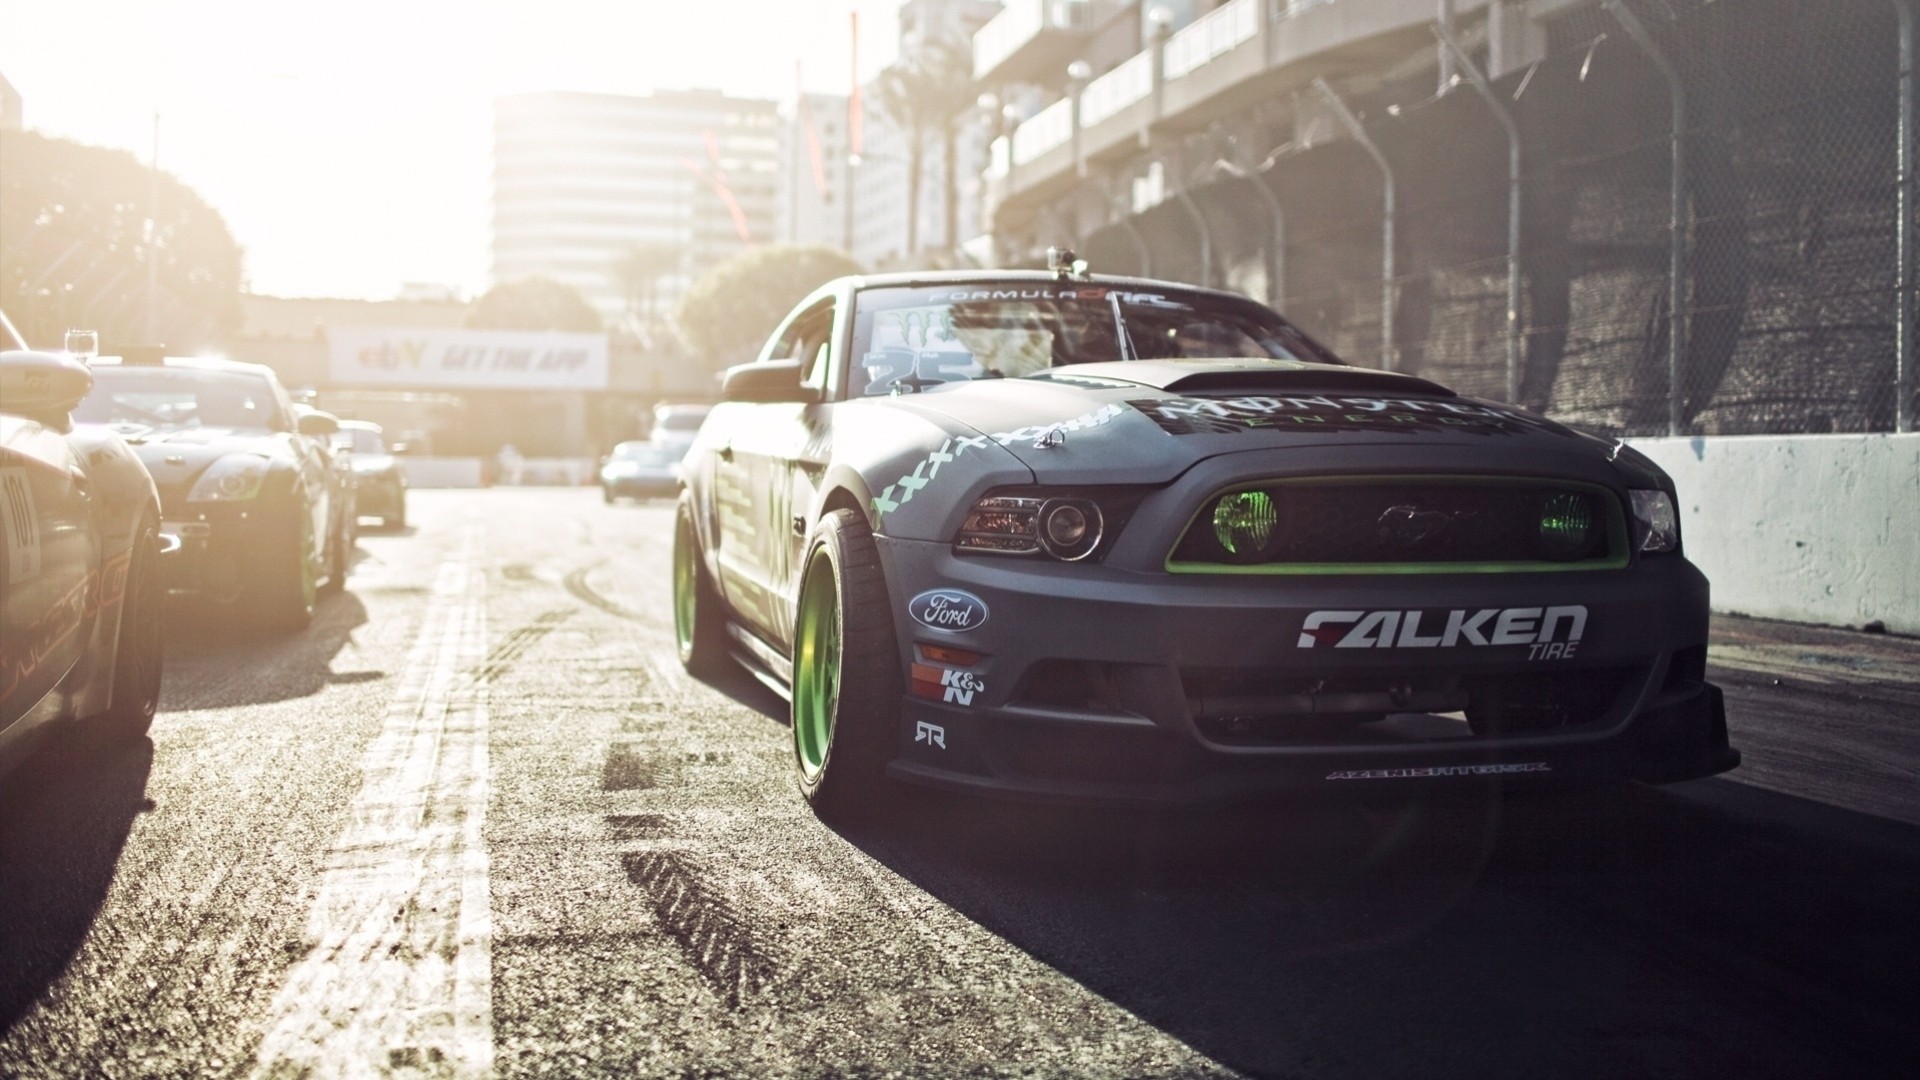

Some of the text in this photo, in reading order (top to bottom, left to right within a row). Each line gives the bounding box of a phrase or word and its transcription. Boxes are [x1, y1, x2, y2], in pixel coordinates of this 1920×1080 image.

[928, 289, 1077, 303] FORMULA
[924, 593, 973, 627] Ford
[1297, 605, 1588, 648] FALKEN
[1528, 641, 1579, 661] TIRE
